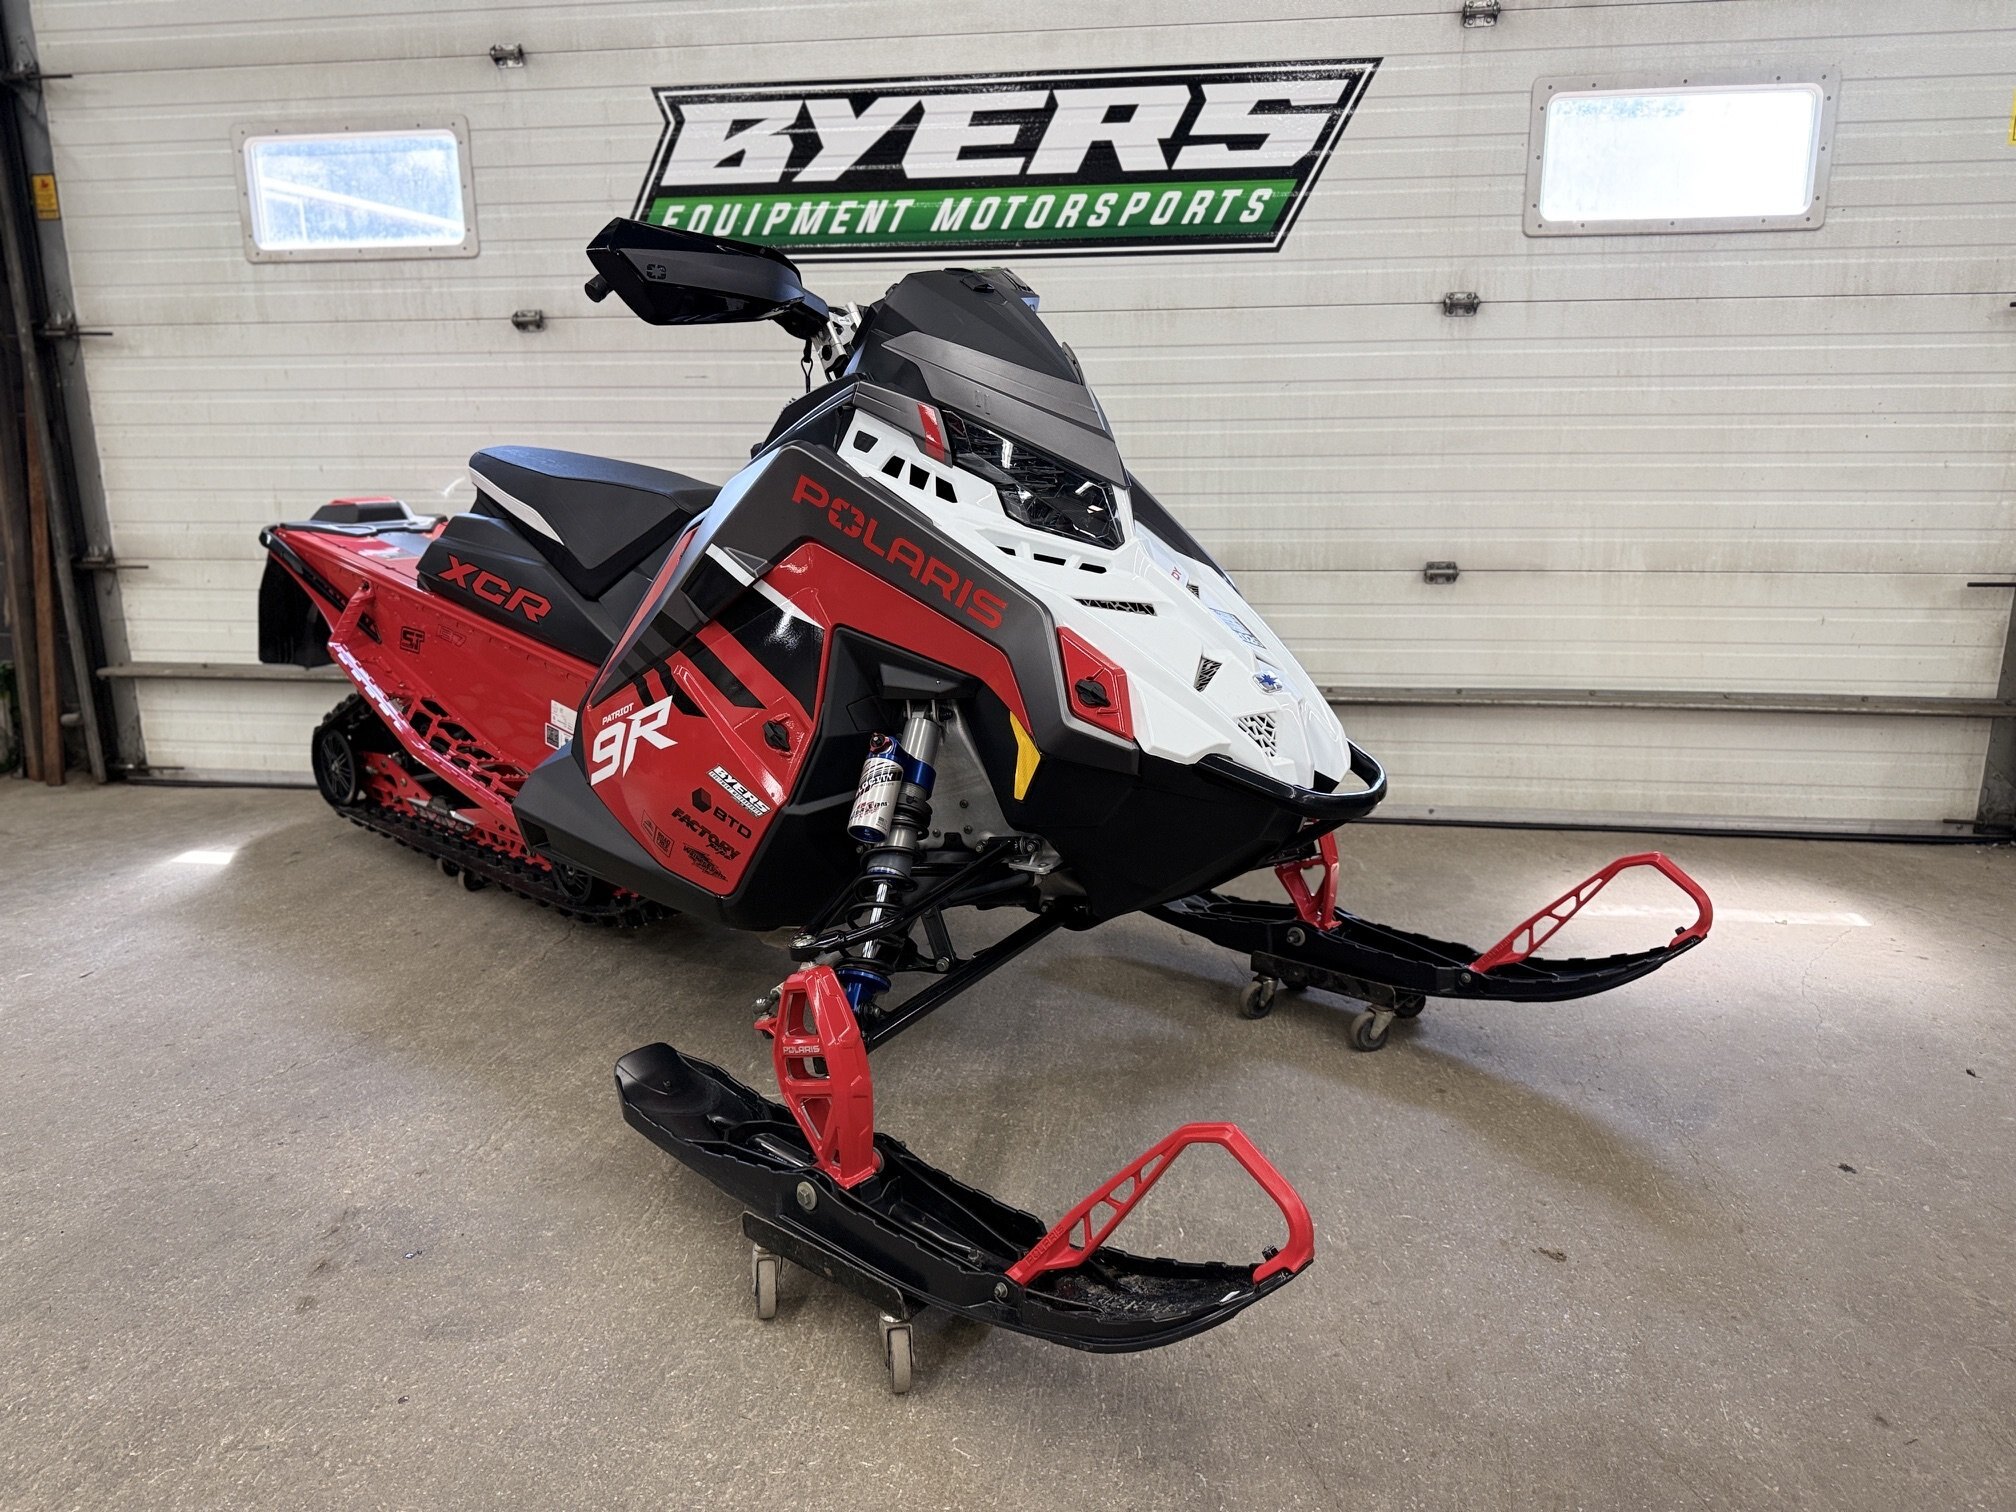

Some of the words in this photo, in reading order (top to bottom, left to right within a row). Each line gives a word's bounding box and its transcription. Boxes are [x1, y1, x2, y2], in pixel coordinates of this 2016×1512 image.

[661, 79, 1351, 186] BYERS
[662, 199, 915, 236] EQUIPMENT
[930, 188, 1274, 231] MOTORSPORTS
[791, 474, 1008, 630] POLARIS
[438, 555, 552, 623] XCR
[602, 702, 634, 725] PATRIOT
[591, 695, 678, 786] 9R
[713, 766, 771, 813] BYERS
[671, 807, 741, 860] FACTORY
[713, 806, 752, 839] BTD
[783, 1045, 820, 1054] POLARIS
